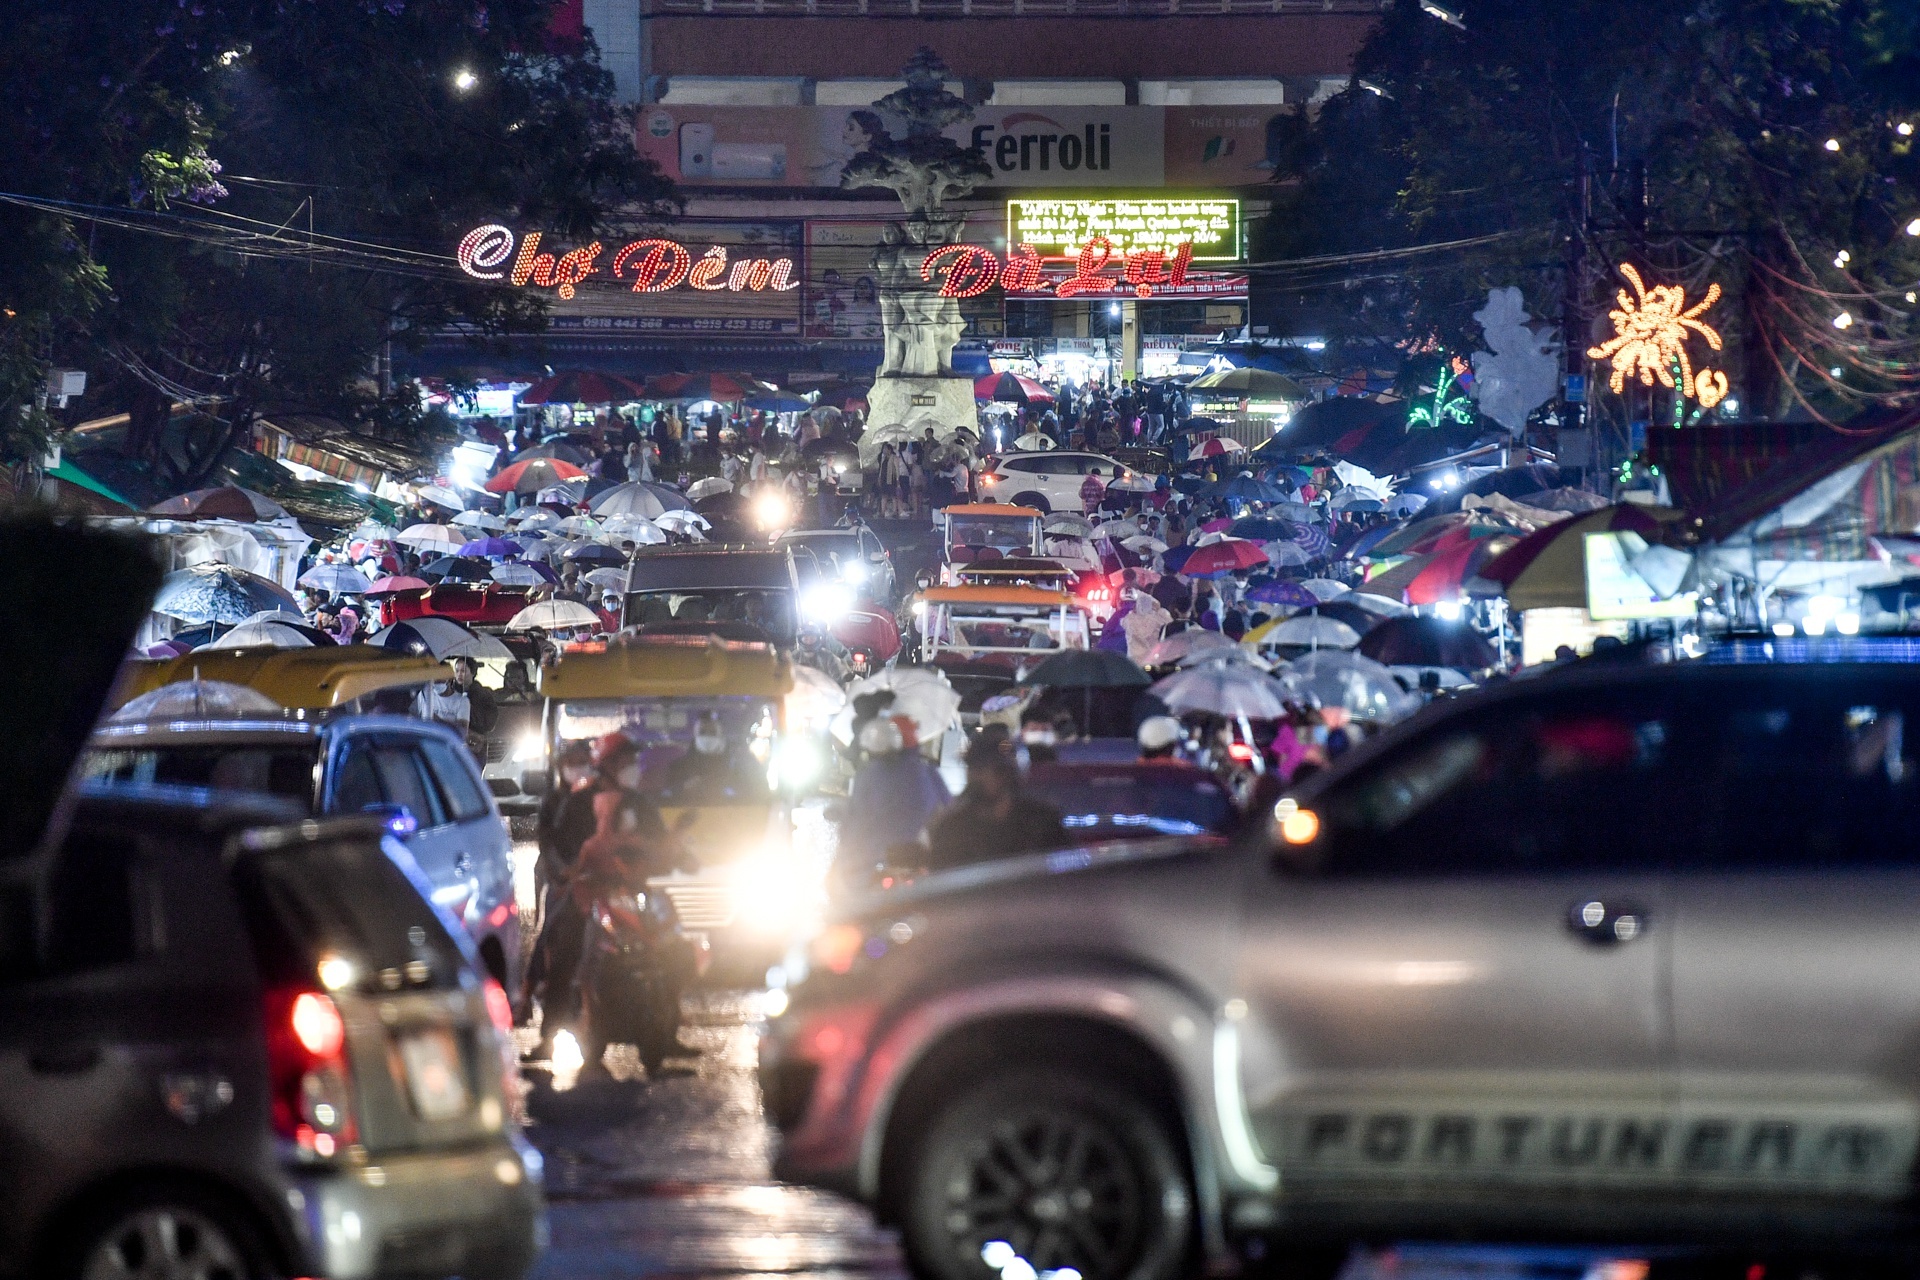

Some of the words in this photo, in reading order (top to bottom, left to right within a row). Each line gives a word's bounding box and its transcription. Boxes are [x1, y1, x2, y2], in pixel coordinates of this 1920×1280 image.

[971, 123, 1111, 171] Ferroli
[456, 223, 603, 301] Chợ
[612, 238, 801, 293] Đêm
[920, 242, 1051, 298] Đà
[1054, 236, 1196, 299] Lạt
[1303, 1110, 1798, 1170] FORTUNER
